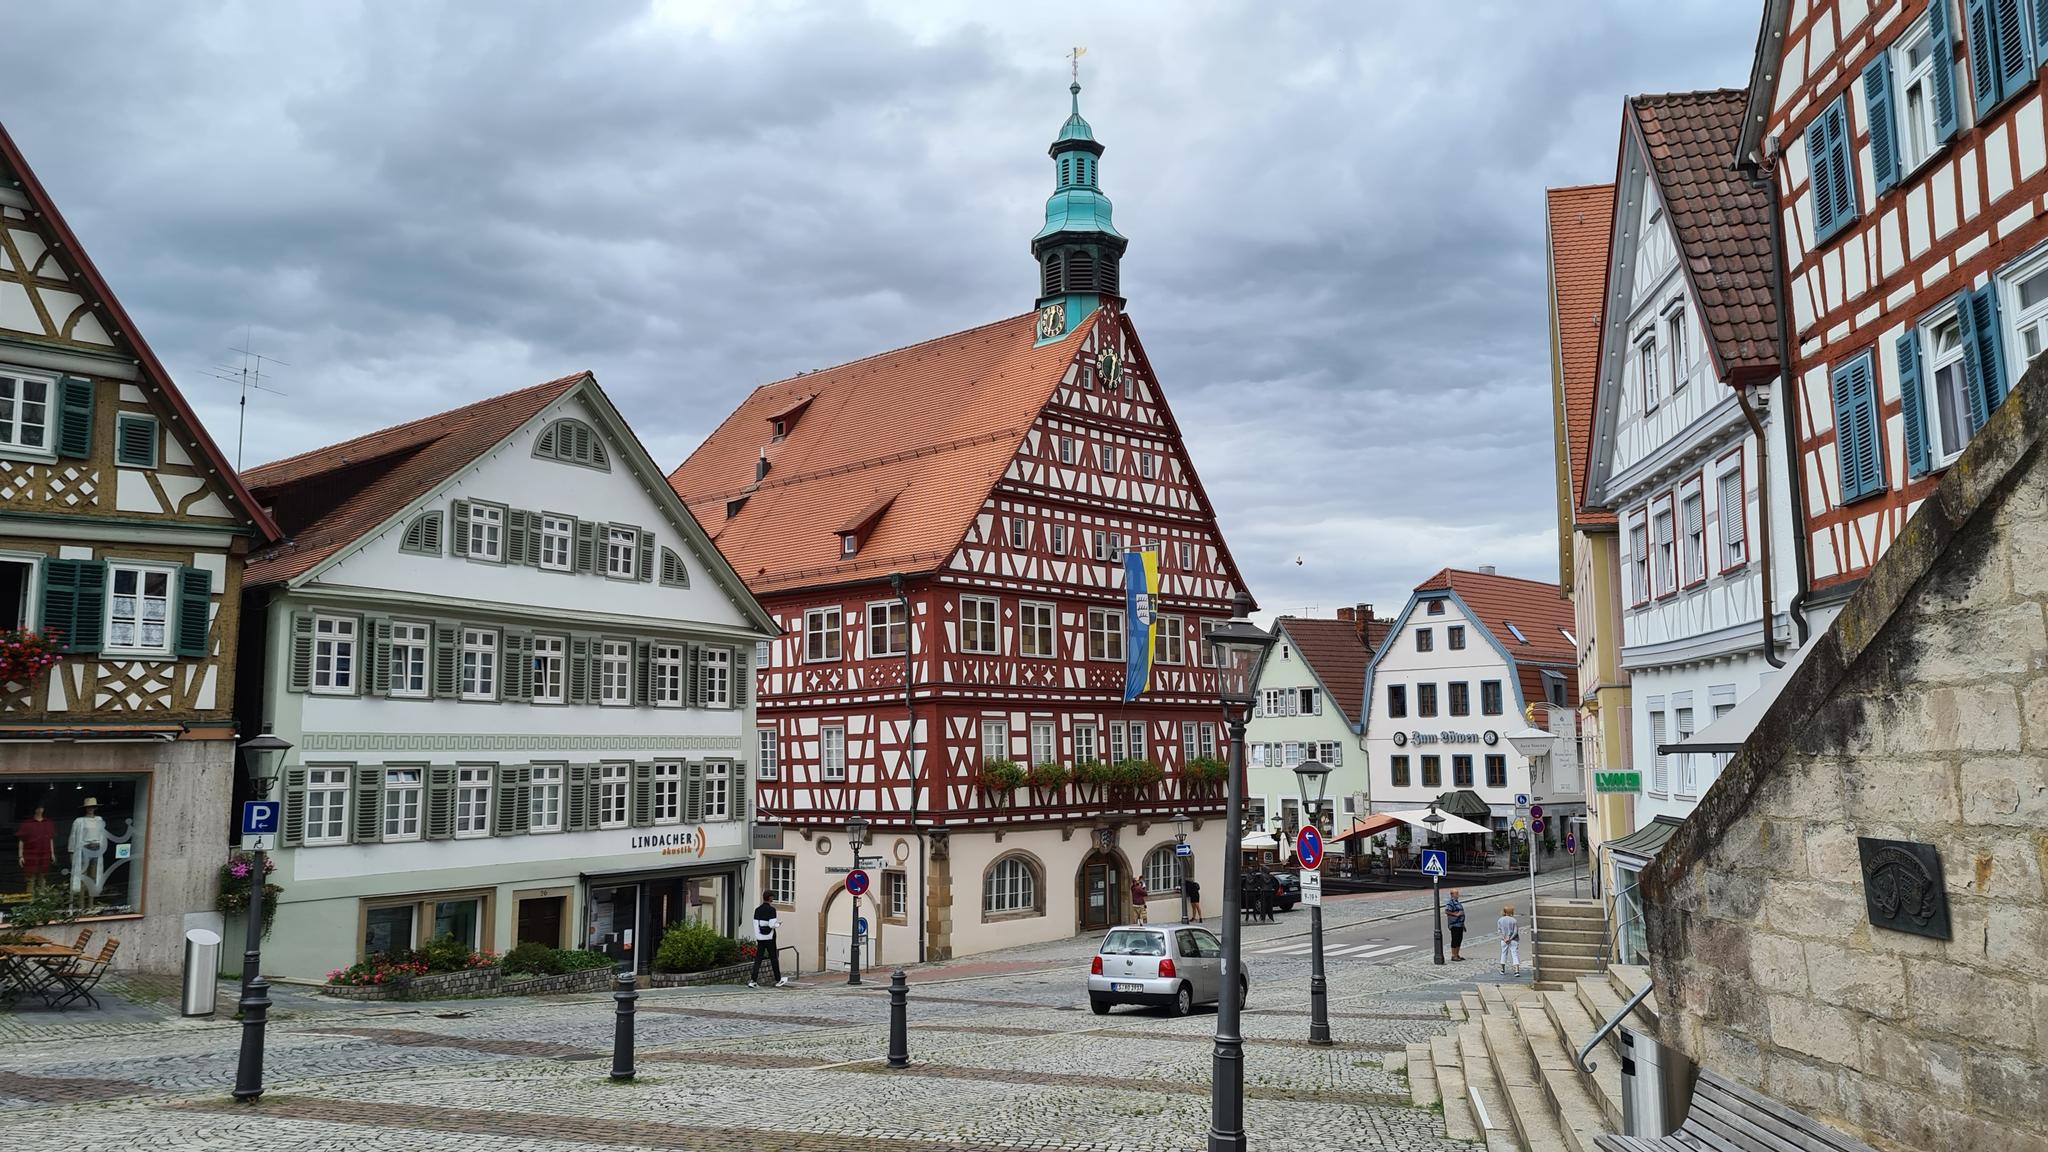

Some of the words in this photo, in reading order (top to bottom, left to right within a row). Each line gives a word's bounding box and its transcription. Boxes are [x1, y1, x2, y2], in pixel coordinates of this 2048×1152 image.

[1595, 772, 1626, 786] LVM
[251, 805, 272, 829] P
[632, 833, 692, 849] LINDACHER
[661, 846, 692, 856] akustik
